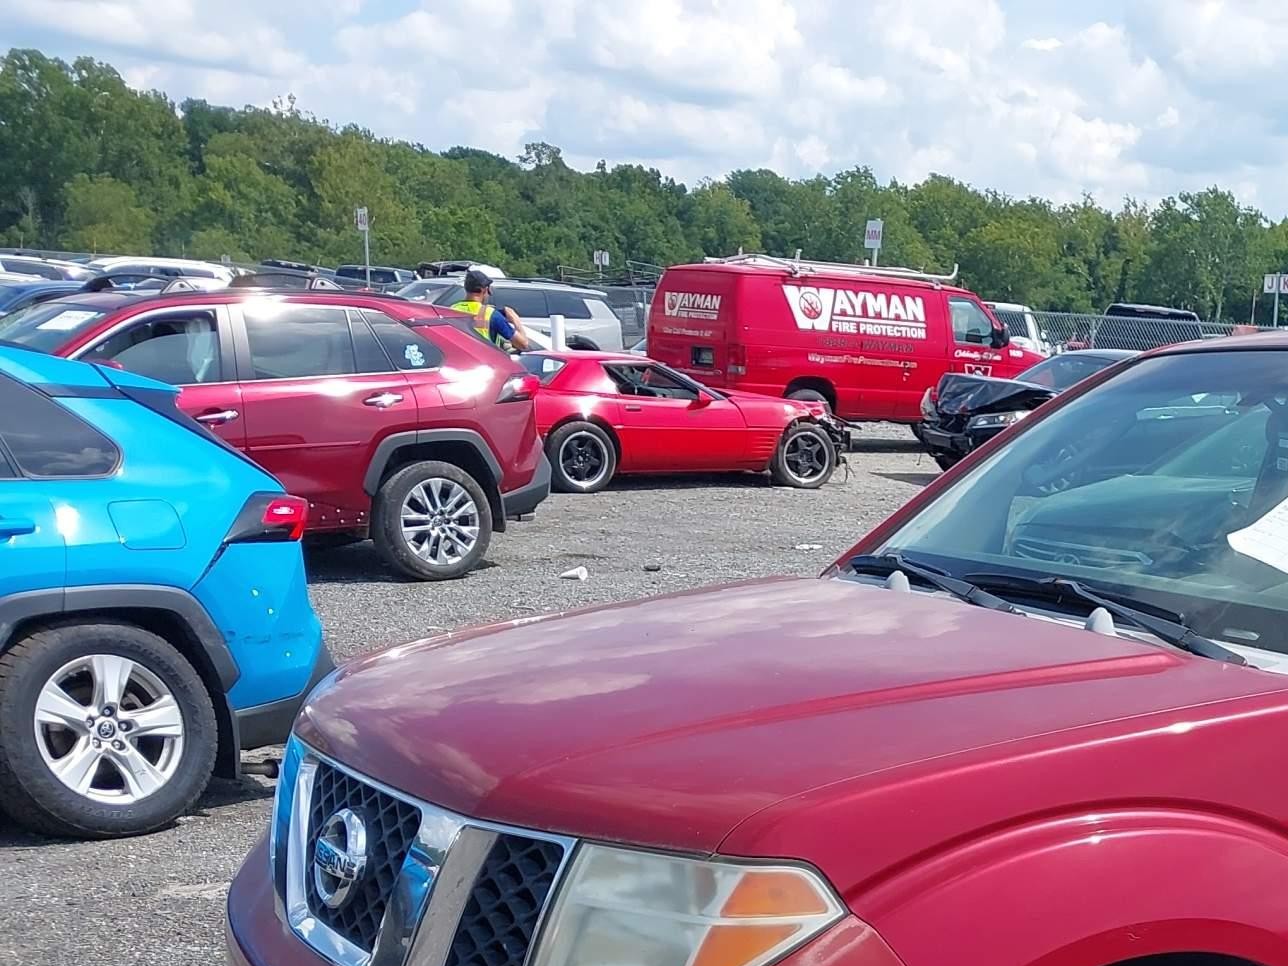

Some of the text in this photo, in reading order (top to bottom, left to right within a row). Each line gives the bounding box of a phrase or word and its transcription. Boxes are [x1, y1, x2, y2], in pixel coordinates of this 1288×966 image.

[1267, 277, 1275, 289] J
[664, 291, 722, 316] WAYMAN
[782, 284, 927, 331] WAYMAN
[831, 320, 927, 340] FIRE PROTECTION
